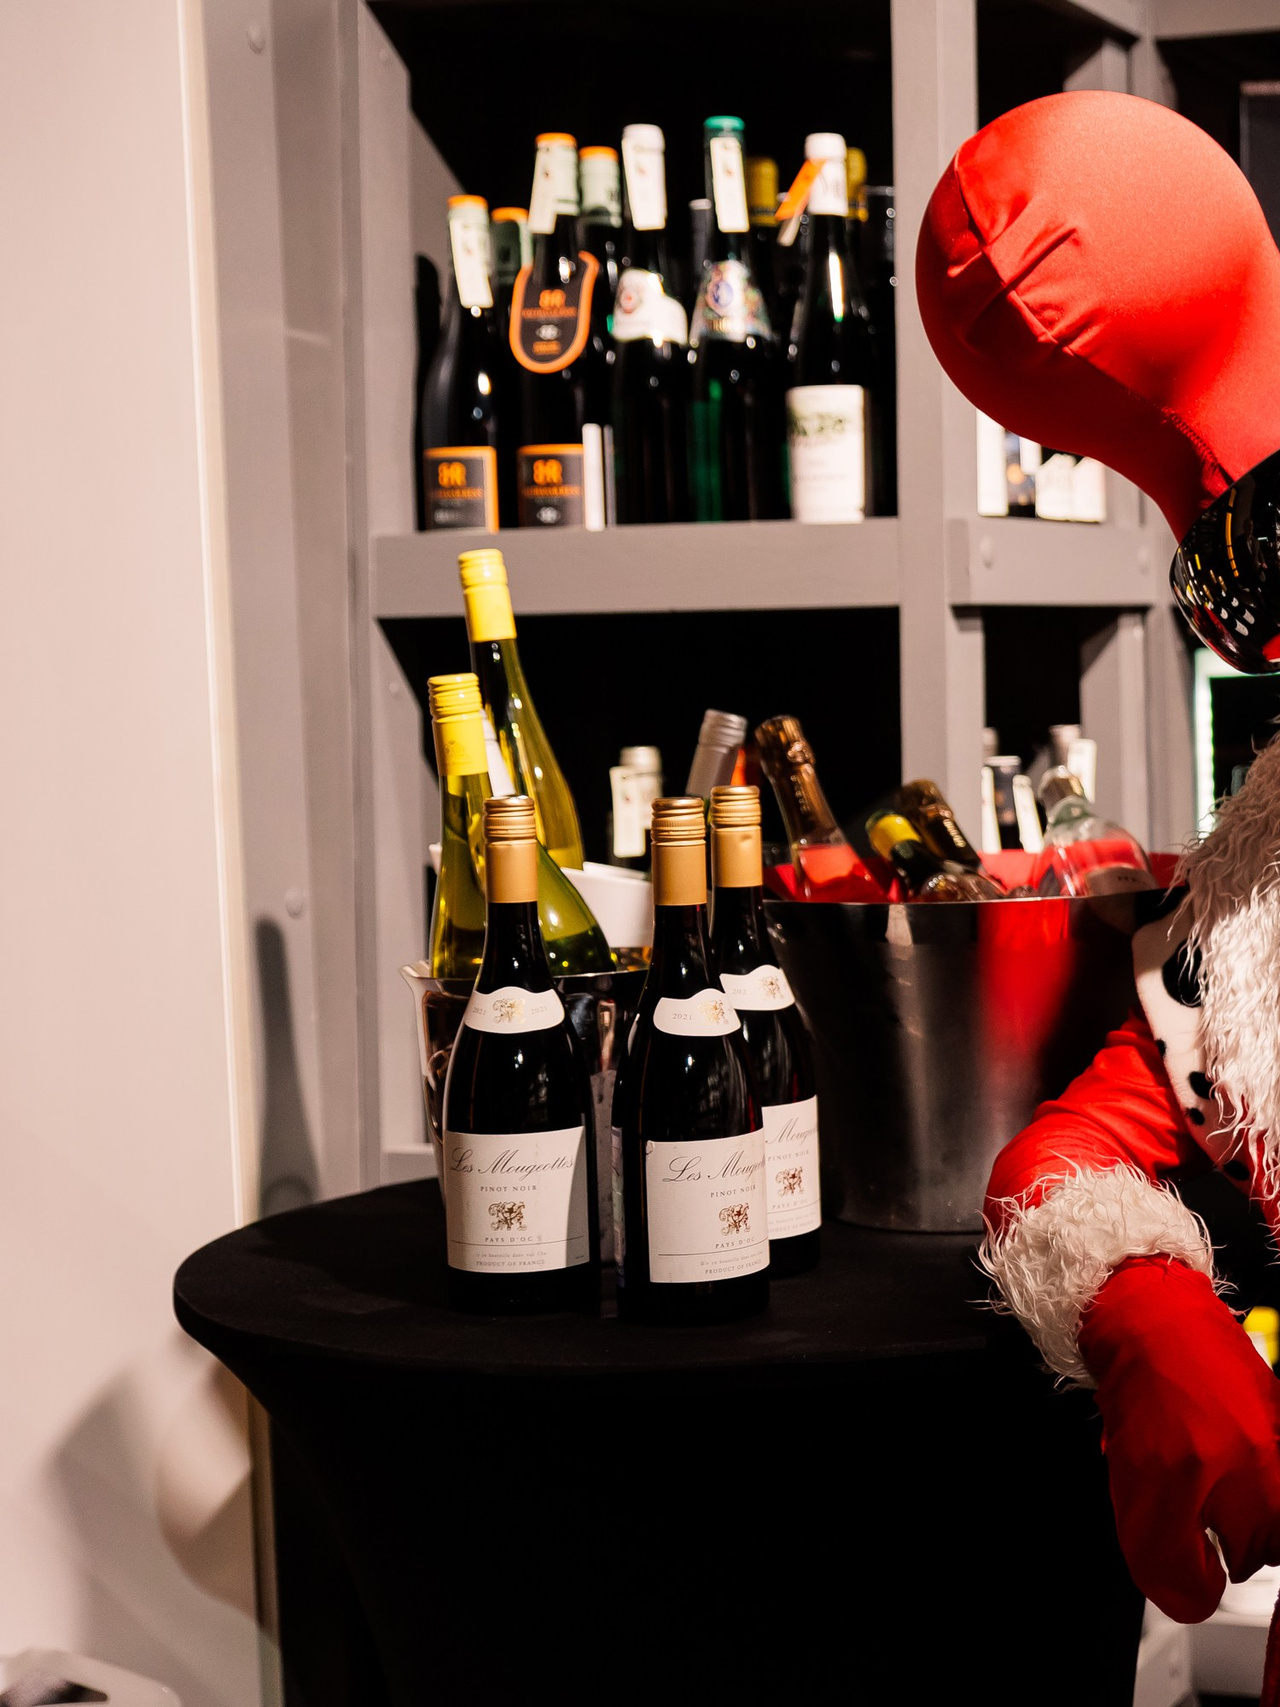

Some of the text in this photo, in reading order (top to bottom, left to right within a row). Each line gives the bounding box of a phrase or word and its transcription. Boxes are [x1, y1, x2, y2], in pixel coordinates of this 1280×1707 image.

[672, 1013, 692, 1021] 2021
[450, 1147, 574, 1181] Les Mougeottes
[662, 1156, 702, 1183] Les
[710, 1184, 757, 1198] PINOT NOIR
[738, 1237, 755, 1245] D'OC
[705, 1265, 735, 1275] PRODUCT
